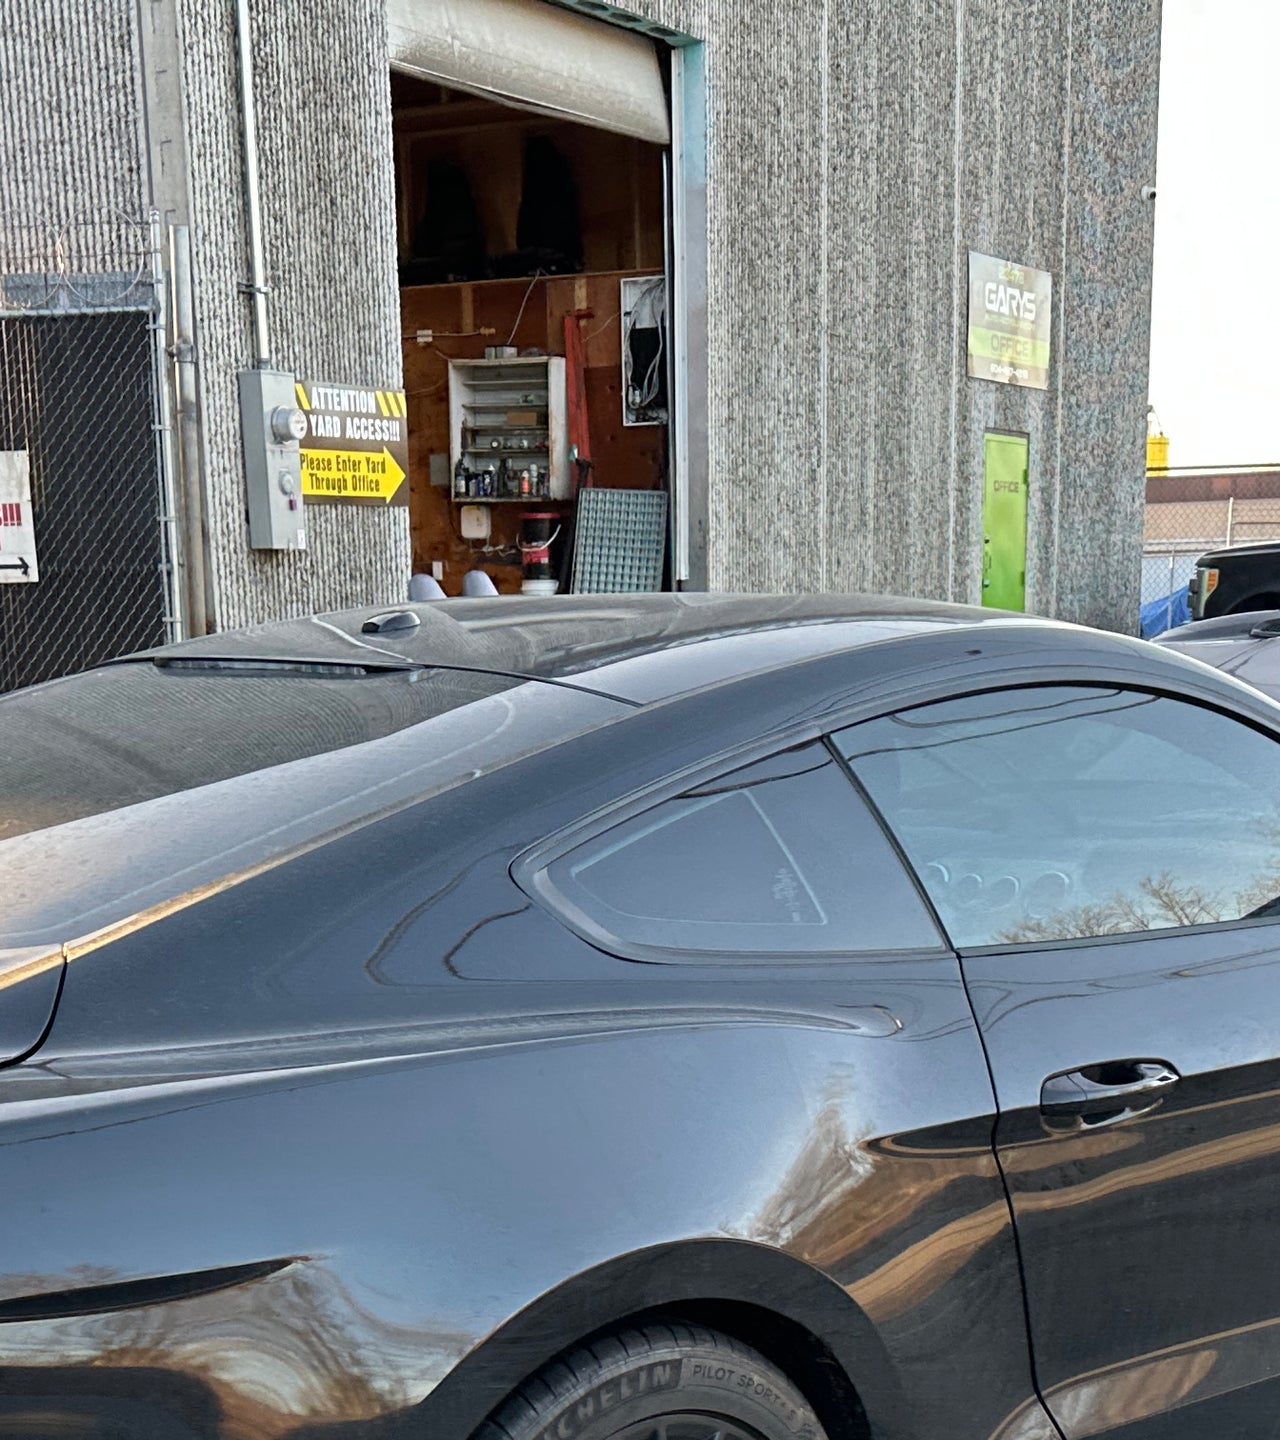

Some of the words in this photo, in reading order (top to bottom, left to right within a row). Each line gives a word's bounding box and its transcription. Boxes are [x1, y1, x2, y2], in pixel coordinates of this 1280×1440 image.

[990, 333, 1031, 358] OFFICE
[311, 386, 376, 414] ATTENTION
[309, 414, 341, 438] YARD
[345, 416, 400, 442] ACCESS!!!
[300, 453, 332, 471] Please
[336, 455, 361, 473] Enter
[365, 456, 386, 474] Yard
[309, 473, 348, 494] Through
[351, 474, 380, 492] Office
[692, 1364, 735, 1381] PILOT
[736, 1374, 781, 1404] SPORT
